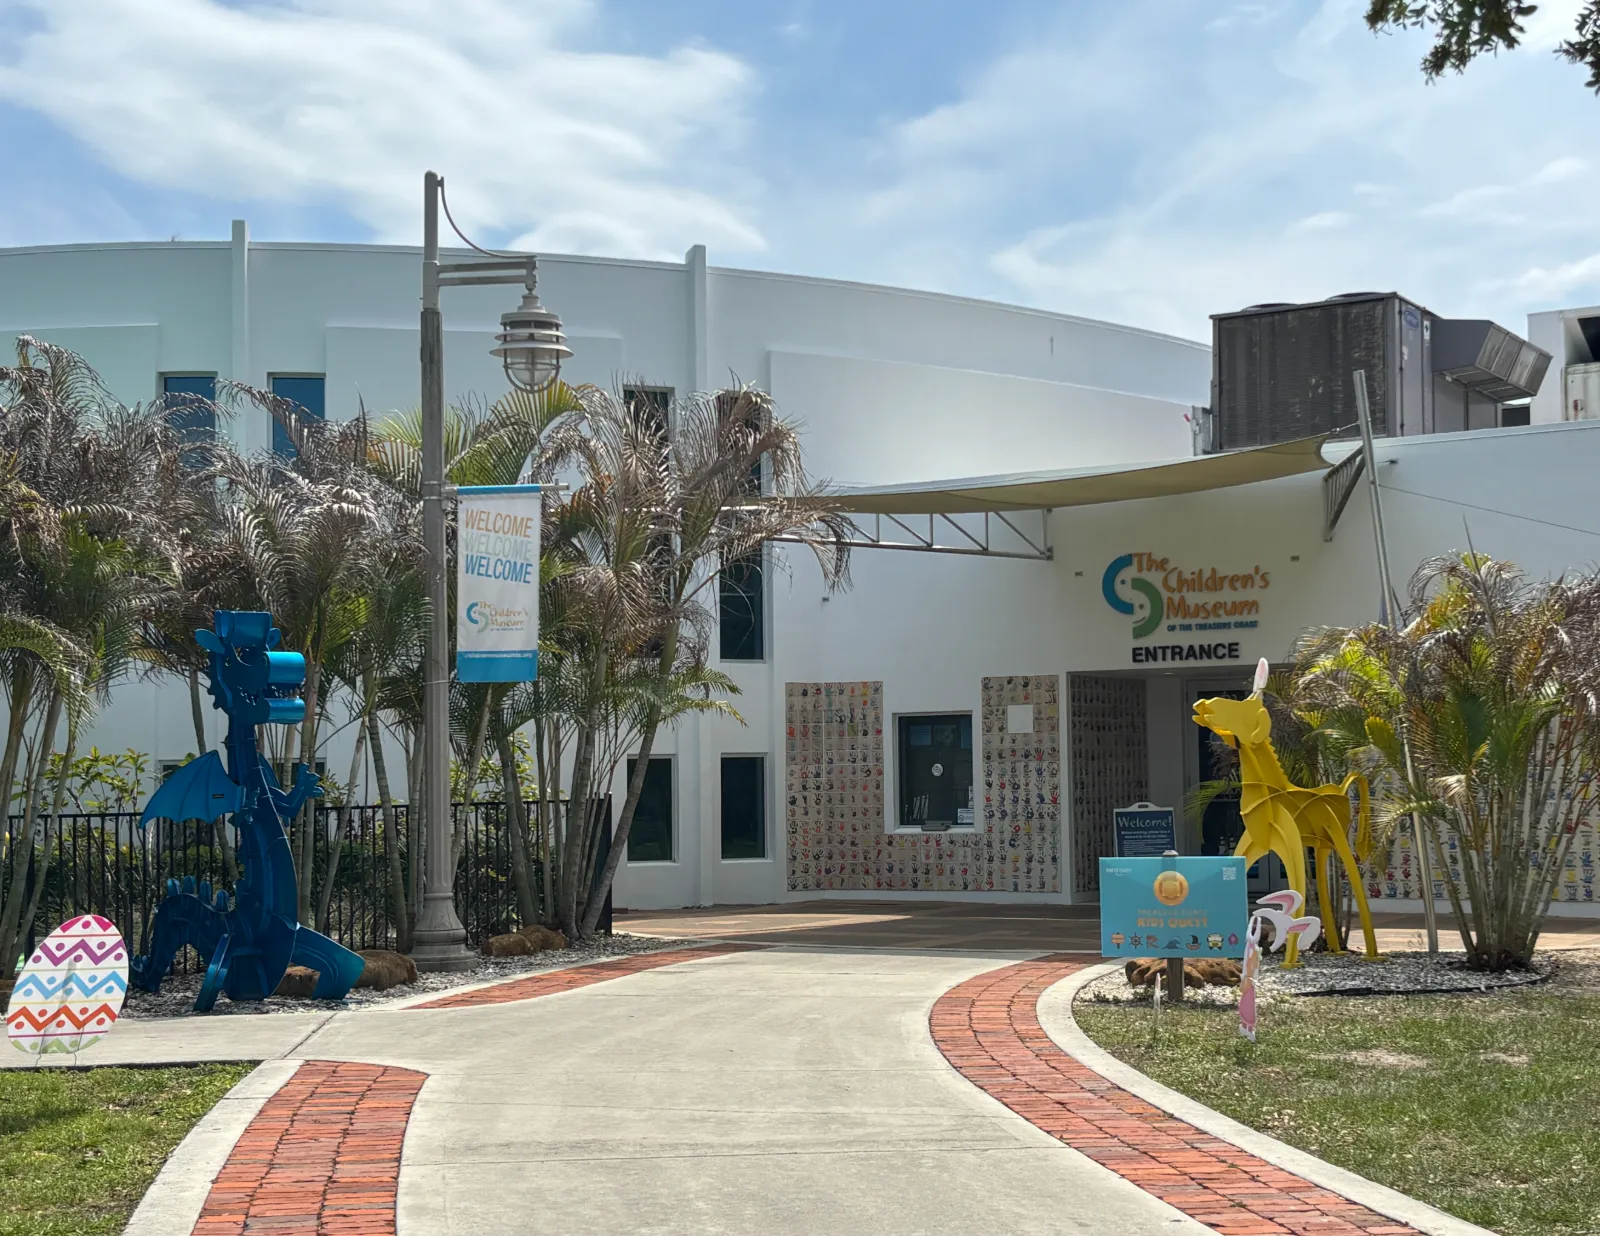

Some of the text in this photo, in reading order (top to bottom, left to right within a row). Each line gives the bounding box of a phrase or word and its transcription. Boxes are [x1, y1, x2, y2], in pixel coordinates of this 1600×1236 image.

[465, 508, 534, 538] WELCOME
[465, 532, 533, 561] WELCOME
[465, 554, 533, 584] WELCOME
[1133, 552, 1170, 574] The
[1162, 565, 1271, 593] Children's
[1166, 596, 1259, 620] Museum
[1167, 620, 1259, 632] OF THE TREASURE COAST
[1132, 643, 1240, 664] ENTRANCE
[1117, 816, 1172, 828] Welcome!
